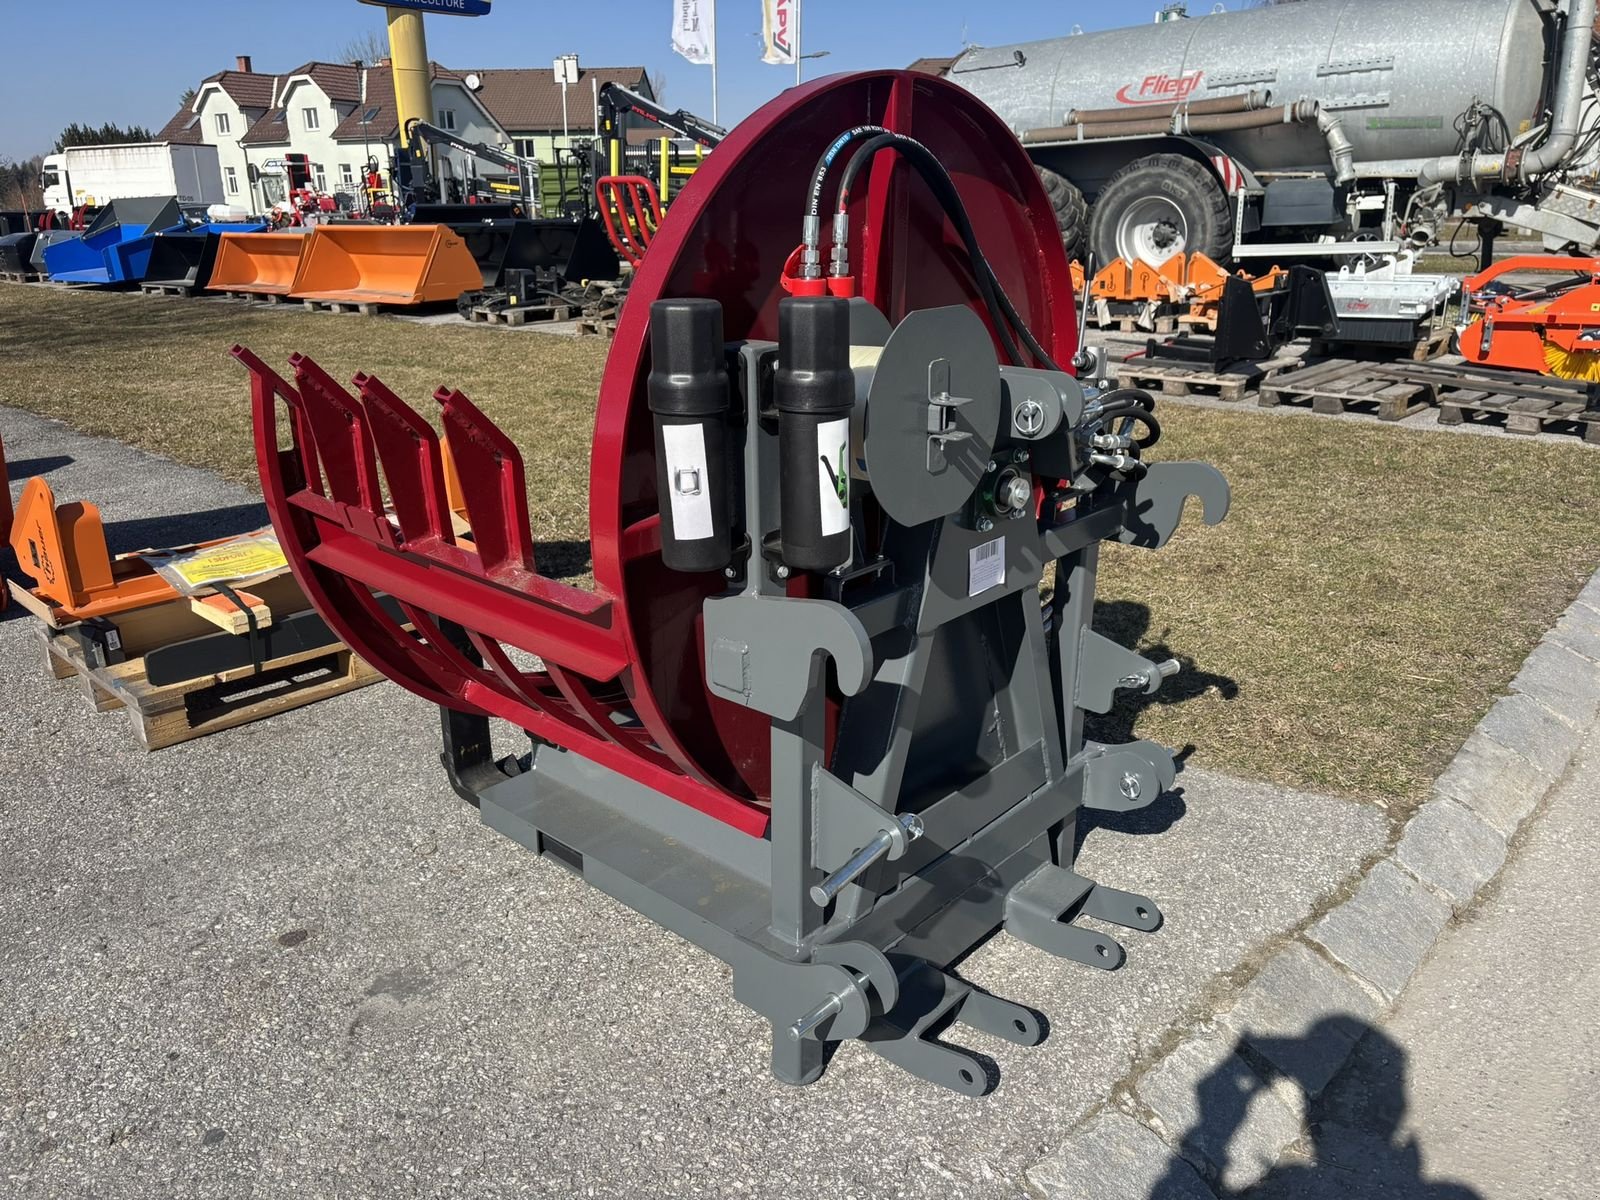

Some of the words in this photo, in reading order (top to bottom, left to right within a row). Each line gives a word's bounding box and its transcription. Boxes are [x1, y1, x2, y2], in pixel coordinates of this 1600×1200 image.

[1139, 70, 1204, 97] Fliegl
[817, 166, 826, 181] 853
[814, 183, 822, 197] EN
